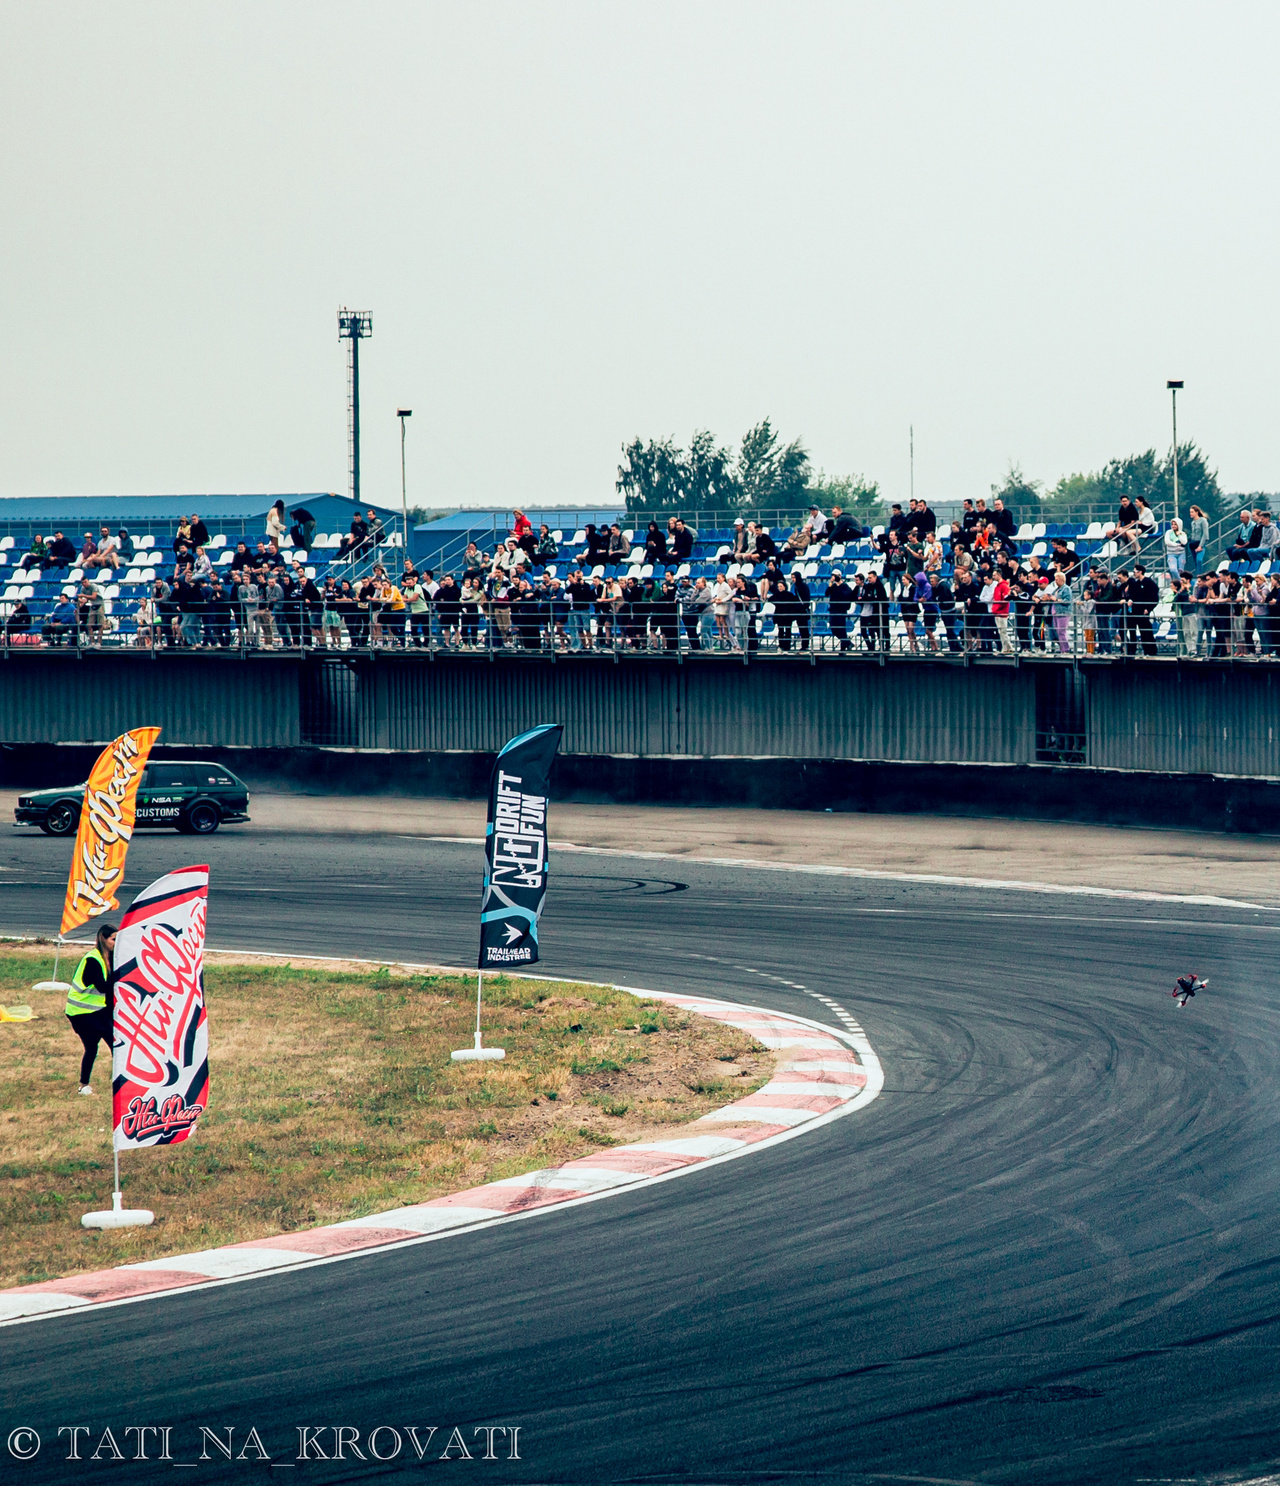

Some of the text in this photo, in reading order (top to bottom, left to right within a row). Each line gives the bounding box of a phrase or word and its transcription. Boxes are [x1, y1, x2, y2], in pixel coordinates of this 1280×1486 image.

[151, 796, 172, 804] NSA
[495, 770, 522, 834] DRIFT
[135, 807, 180, 818] CUSTOMS
[520, 794, 545, 836] FUN
[487, 946, 531, 955] TRAILHEAD
